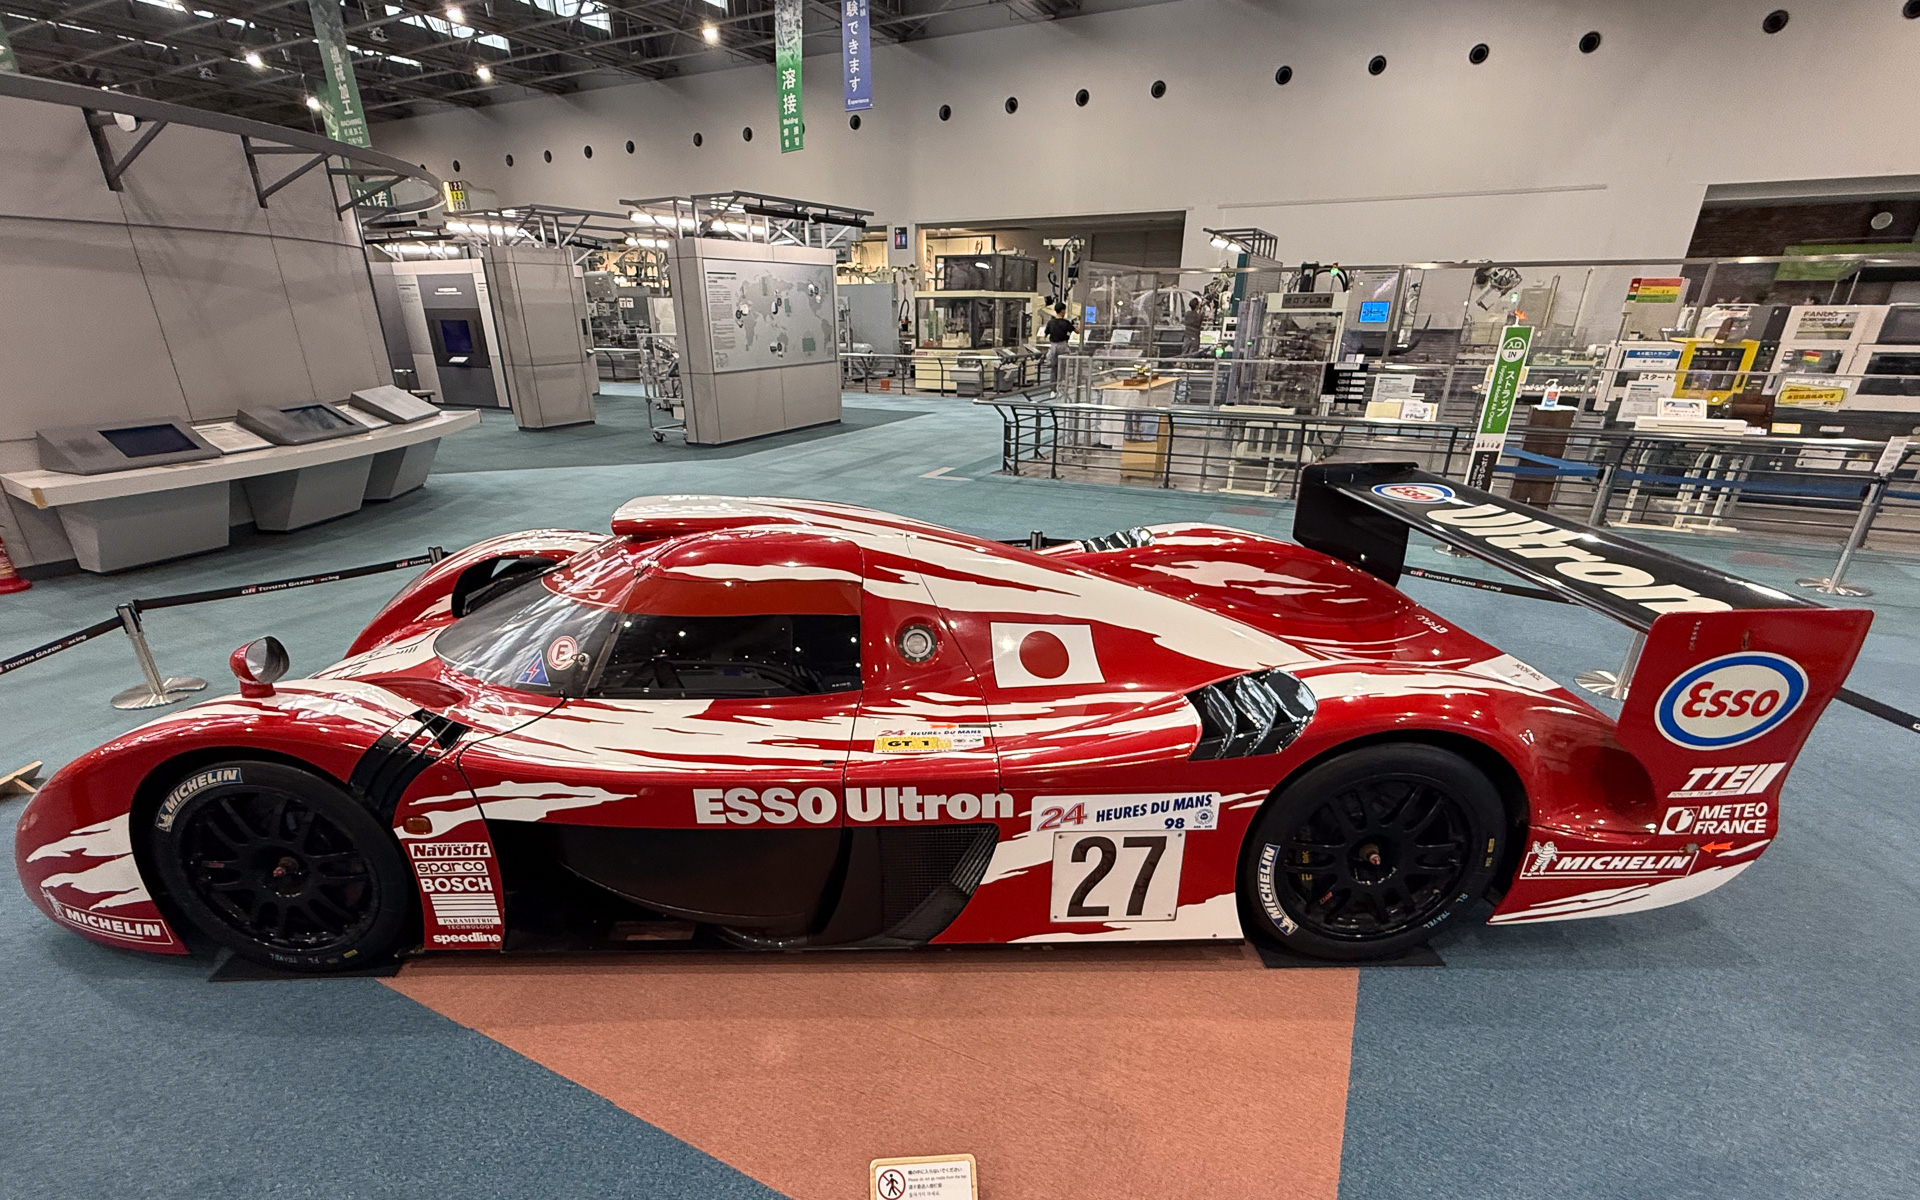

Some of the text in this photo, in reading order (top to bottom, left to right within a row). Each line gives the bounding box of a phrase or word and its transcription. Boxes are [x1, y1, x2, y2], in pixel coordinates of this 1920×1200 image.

[781, 67, 798, 115] 溶接
[1506, 341, 1522, 350] 入口
[1507, 350, 1517, 359] IN
[1641, 373, 1673, 381] スタート
[1496, 370, 1515, 418] ストラップ
[1427, 503, 1733, 613] Ultron
[878, 729, 906, 737] 24
[164, 768, 239, 815] MICHELIN
[692, 786, 1014, 825] ESSO Ultron
[1037, 793, 1213, 832] 24 HEURES DU MANS
[1699, 802, 1769, 819] METEO
[1163, 817, 1186, 830] 98
[1692, 818, 1767, 835] FRANCE
[413, 841, 488, 858] Navisoft
[417, 861, 486, 876] sparco
[1553, 855, 1692, 871] MICHELIN
[419, 877, 494, 893] BOSCH
[1066, 835, 1168, 918] 27
[1258, 845, 1284, 921] MICHELIN
[66, 908, 162, 938] MICHELIN
[442, 917, 495, 925] PARAMETRIC
[1422, 910, 1451, 929] TRAVEL
[433, 931, 502, 944] speedline
